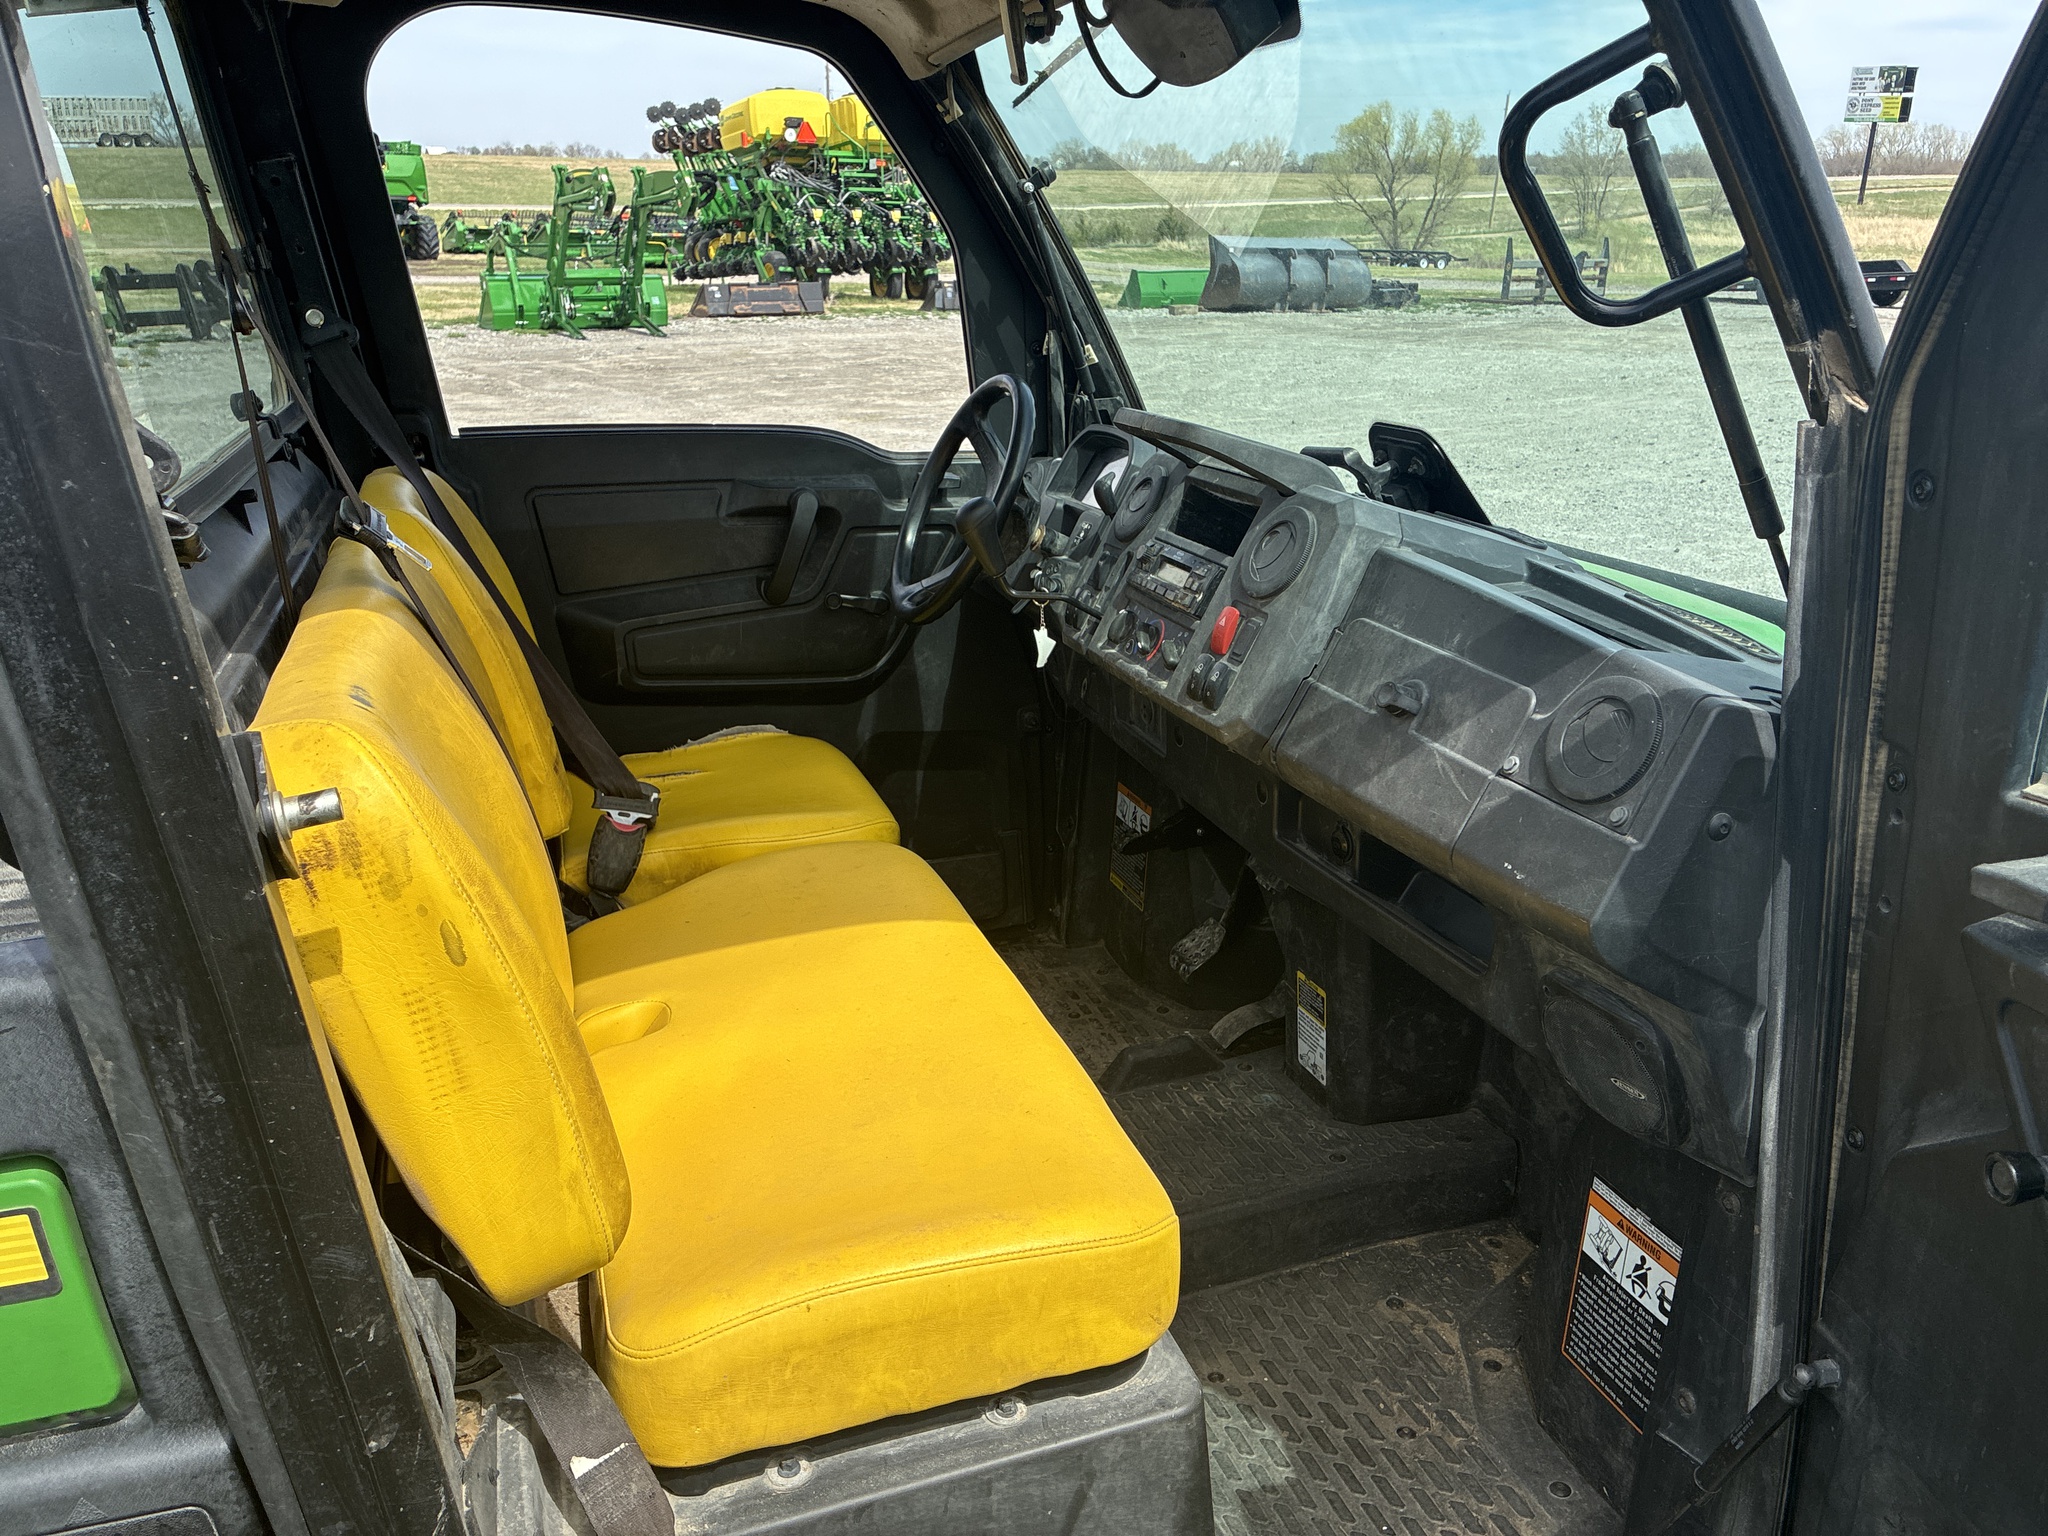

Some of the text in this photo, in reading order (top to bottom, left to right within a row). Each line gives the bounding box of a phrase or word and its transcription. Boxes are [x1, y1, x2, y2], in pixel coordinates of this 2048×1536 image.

[830, 157, 838, 174] 2
[1625, 1223, 1661, 1261] WARNING
[1593, 1273, 1605, 1290] From
[1605, 1285, 1626, 1309] Rollover
[1633, 1310, 1652, 1333] Falling
[1602, 1272, 1616, 1290] Avoid
[1615, 1285, 1631, 1306] Injury
[1638, 1305, 1654, 1324] Death
